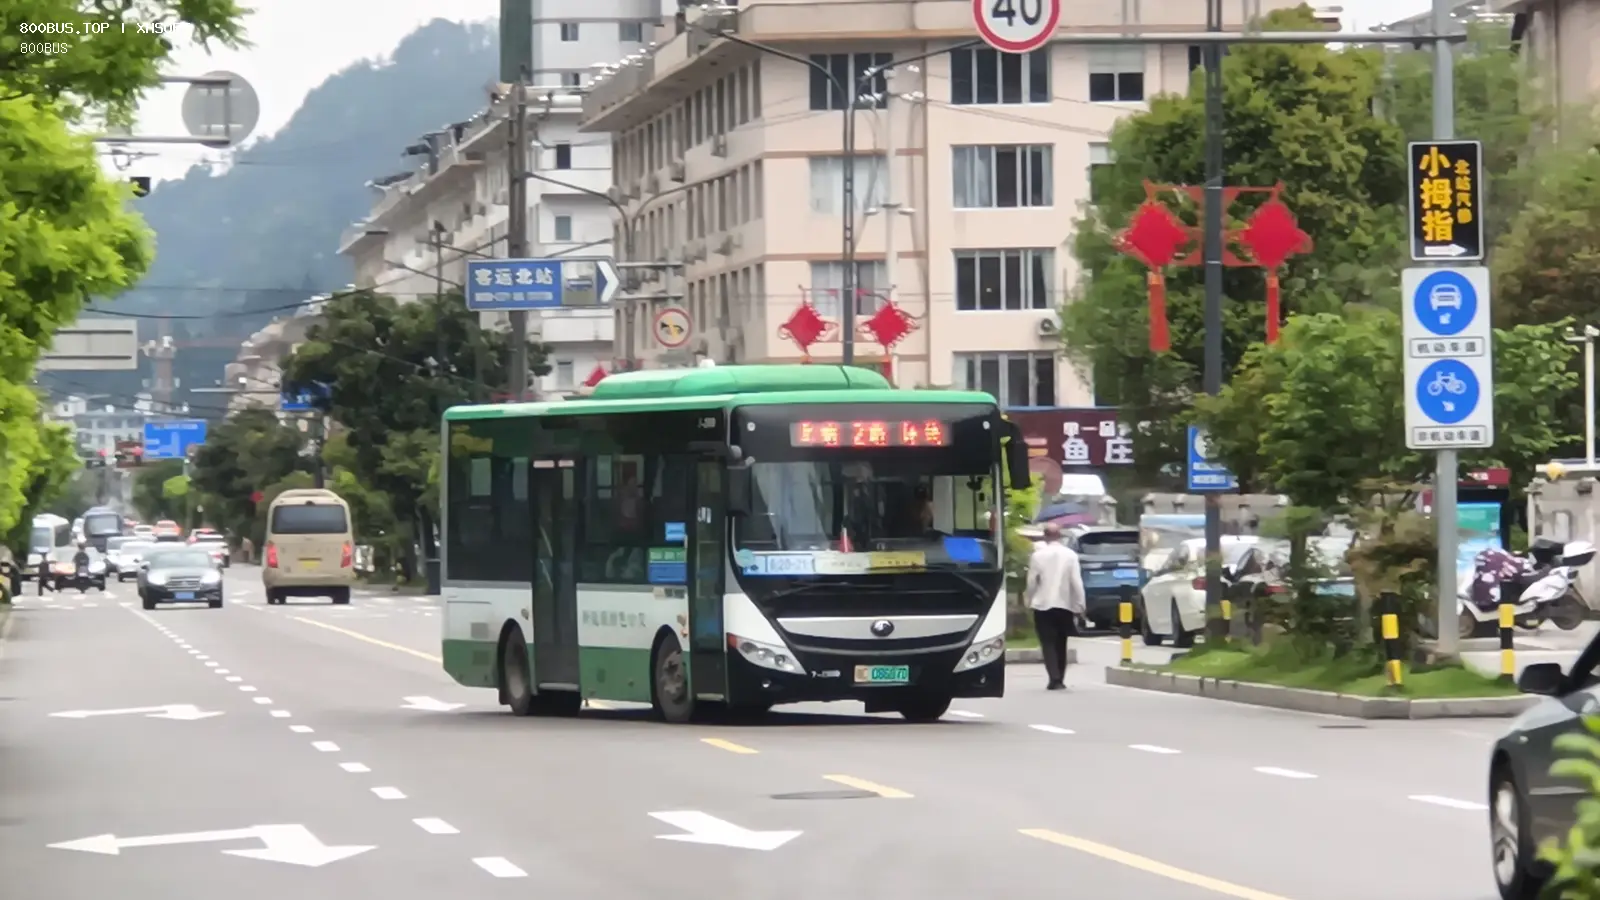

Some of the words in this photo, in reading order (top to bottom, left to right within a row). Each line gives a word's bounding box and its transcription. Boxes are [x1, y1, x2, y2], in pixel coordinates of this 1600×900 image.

[992, 0, 1042, 27] 40
[1419, 146, 1454, 241] 小拇指
[474, 268, 553, 286] 客运北站
[1417, 341, 1477, 355] 机动车道
[1418, 430, 1480, 442] 非机动车道
[1061, 436, 1135, 465] 鱼庄
